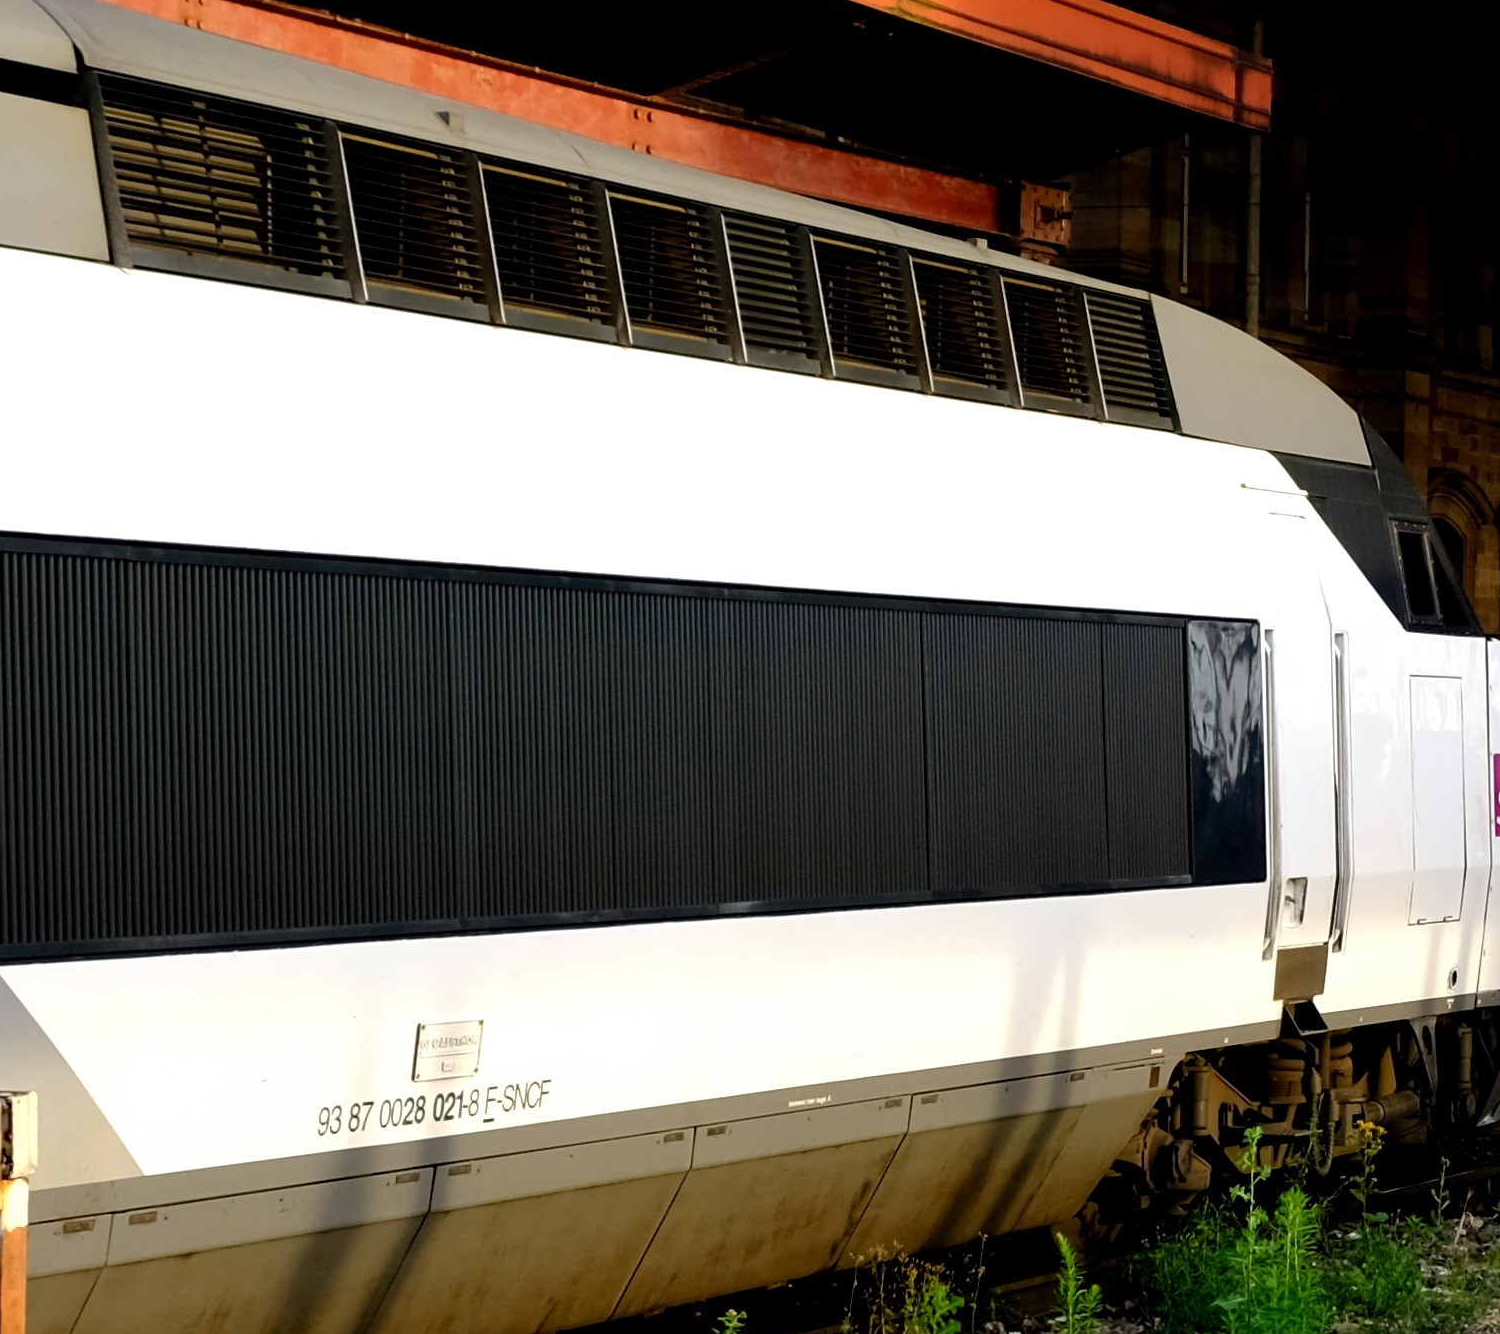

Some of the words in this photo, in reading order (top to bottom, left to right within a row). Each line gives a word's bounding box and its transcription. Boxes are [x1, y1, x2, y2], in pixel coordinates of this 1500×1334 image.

[318, 1104, 341, 1137] 93
[348, 1100, 374, 1133] 87
[379, 1094, 426, 1128] 0028
[432, 1088, 480, 1123] 021-8
[483, 1079, 552, 1123] F-SNCF
